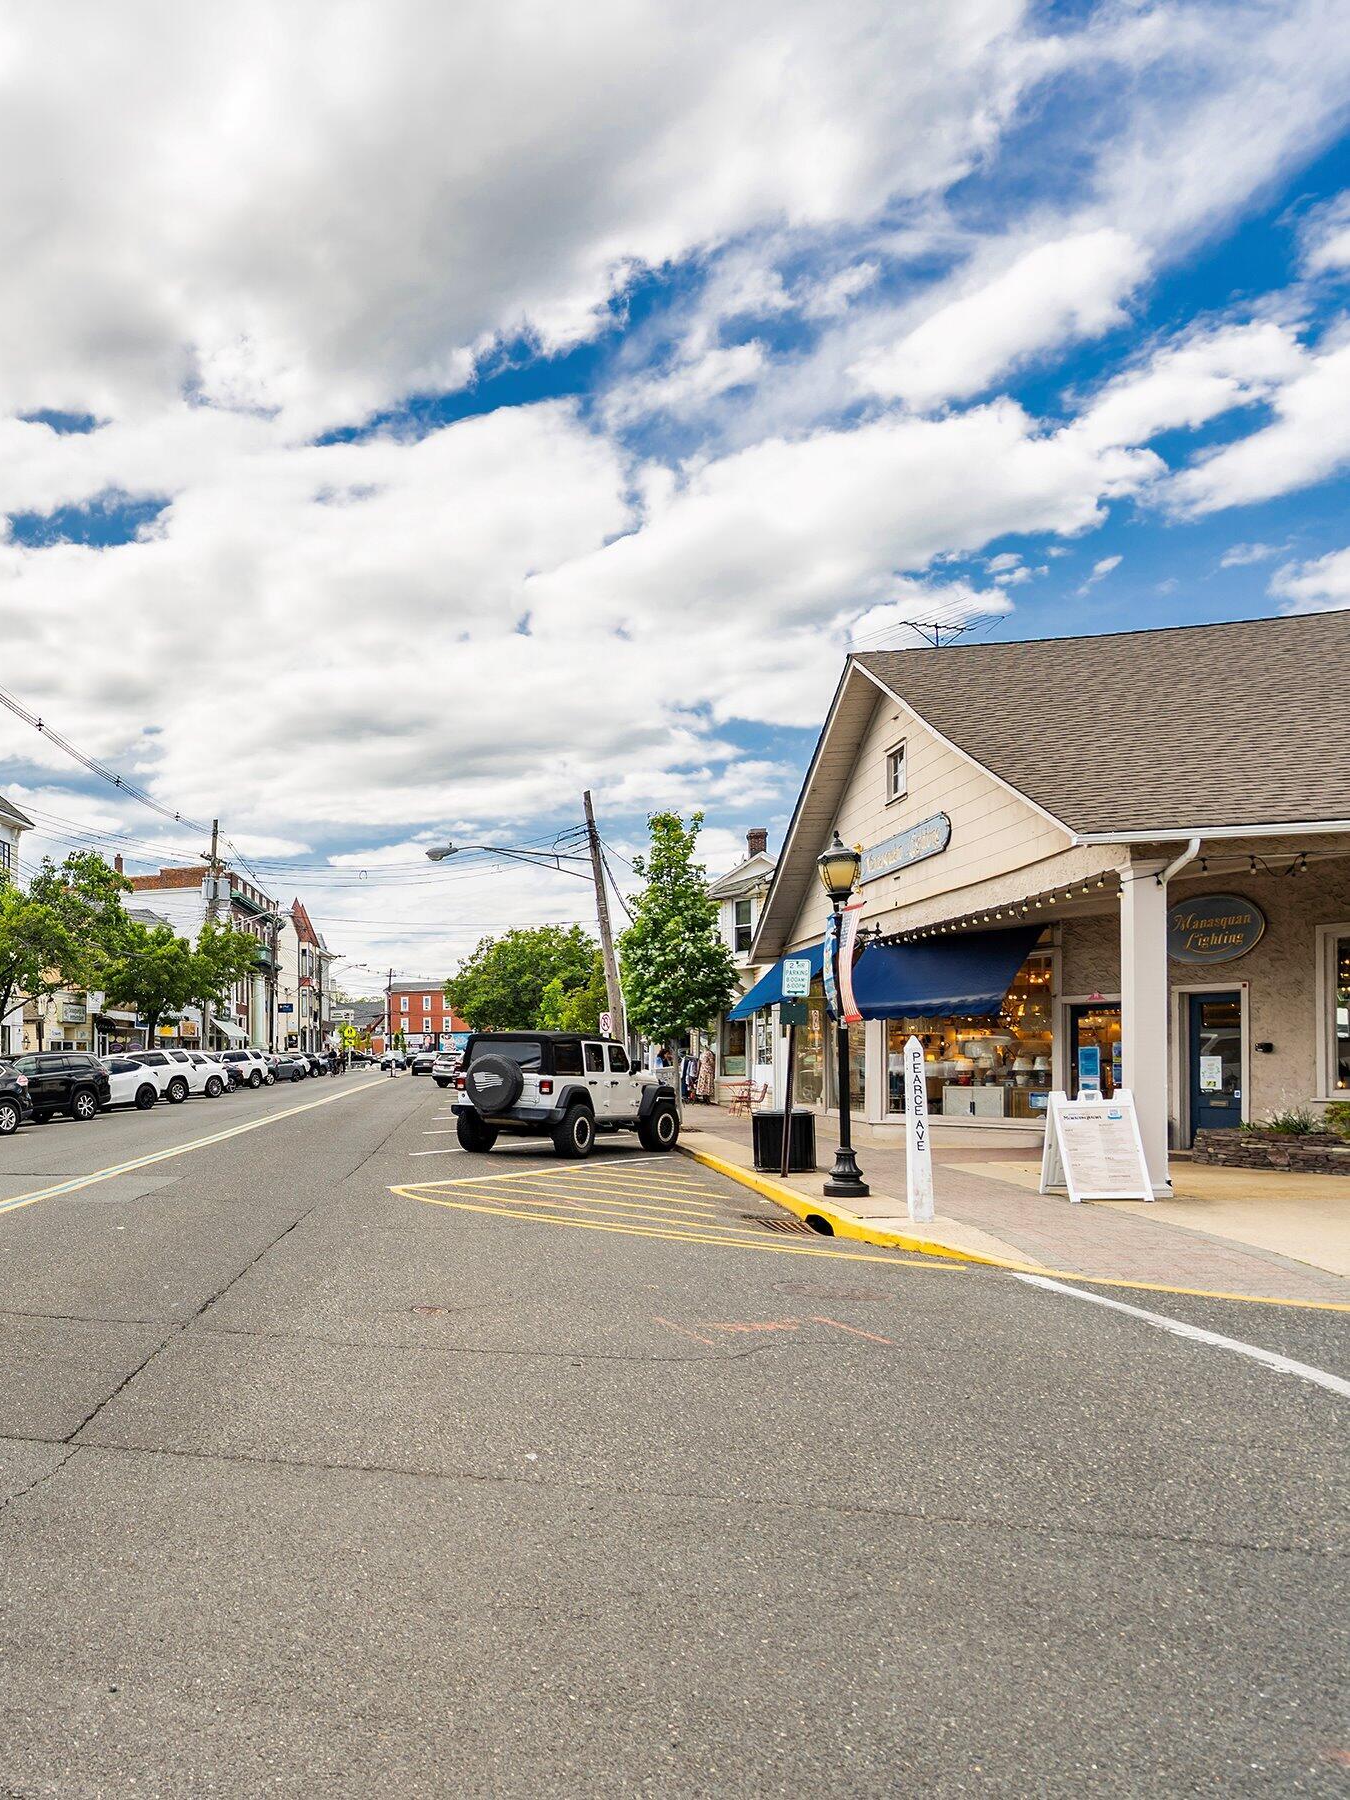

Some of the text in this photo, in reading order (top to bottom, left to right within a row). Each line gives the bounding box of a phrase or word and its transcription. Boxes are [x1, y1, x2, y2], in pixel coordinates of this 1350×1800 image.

[1172, 913, 1251, 932] Manasquan
[1185, 931, 1244, 950] Lighting
[912, 1052, 925, 1151] PEARCE AVE
